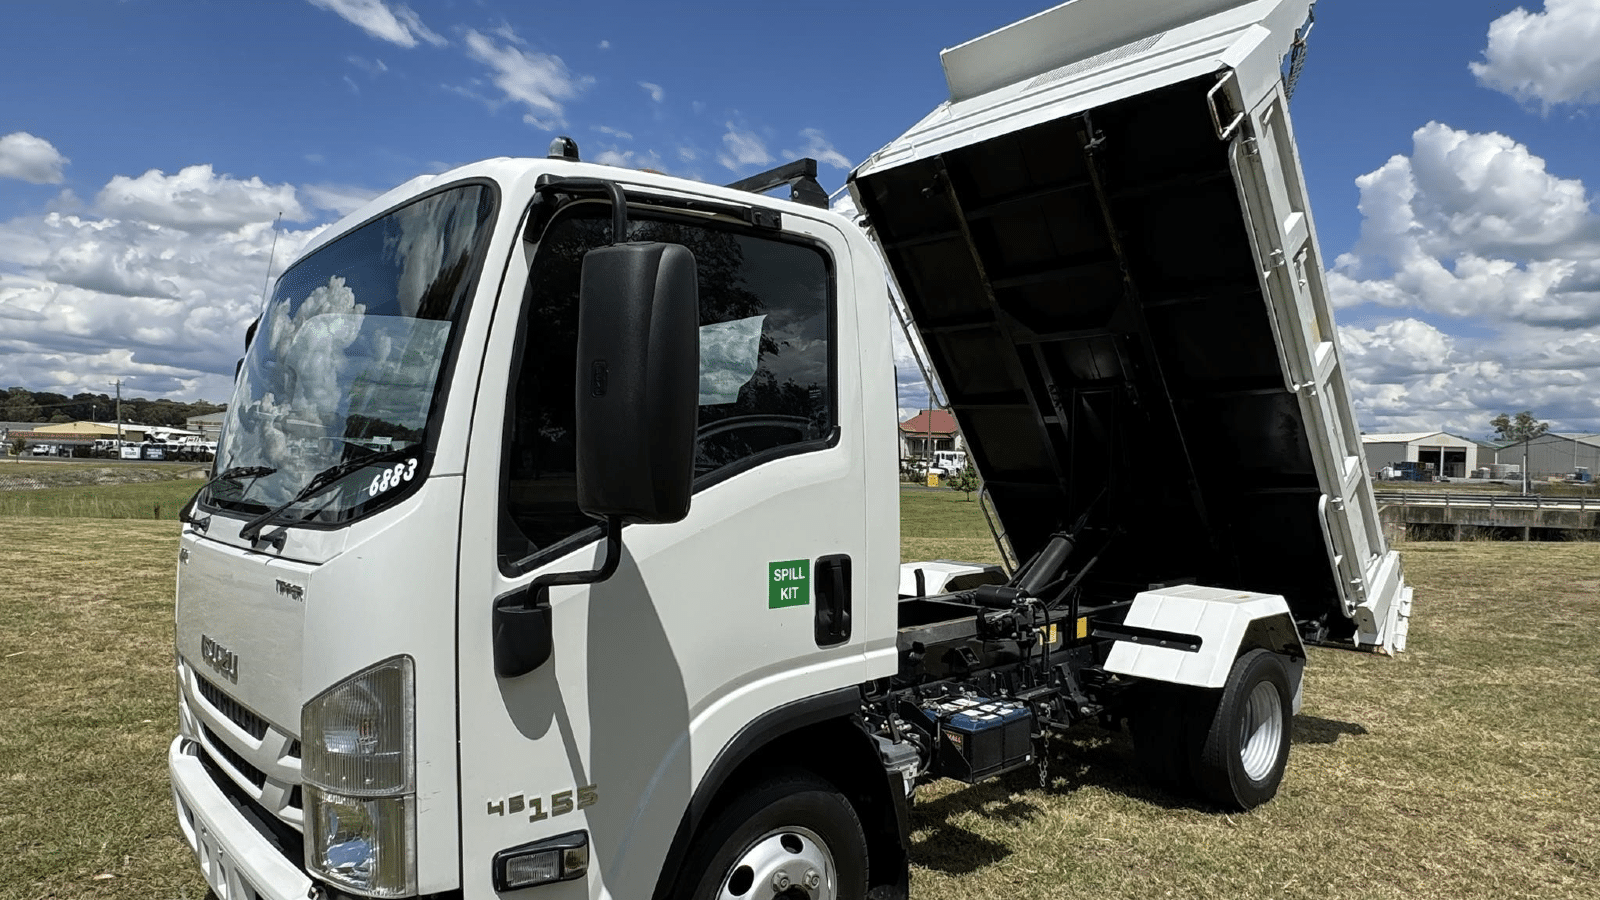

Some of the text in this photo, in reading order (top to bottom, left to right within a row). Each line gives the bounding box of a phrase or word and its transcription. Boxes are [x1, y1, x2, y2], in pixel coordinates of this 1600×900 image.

[369, 457, 418, 497] 6883
[773, 566, 806, 582] SPILL
[780, 586, 800, 600] KIT
[201, 634, 239, 686] ISUZU
